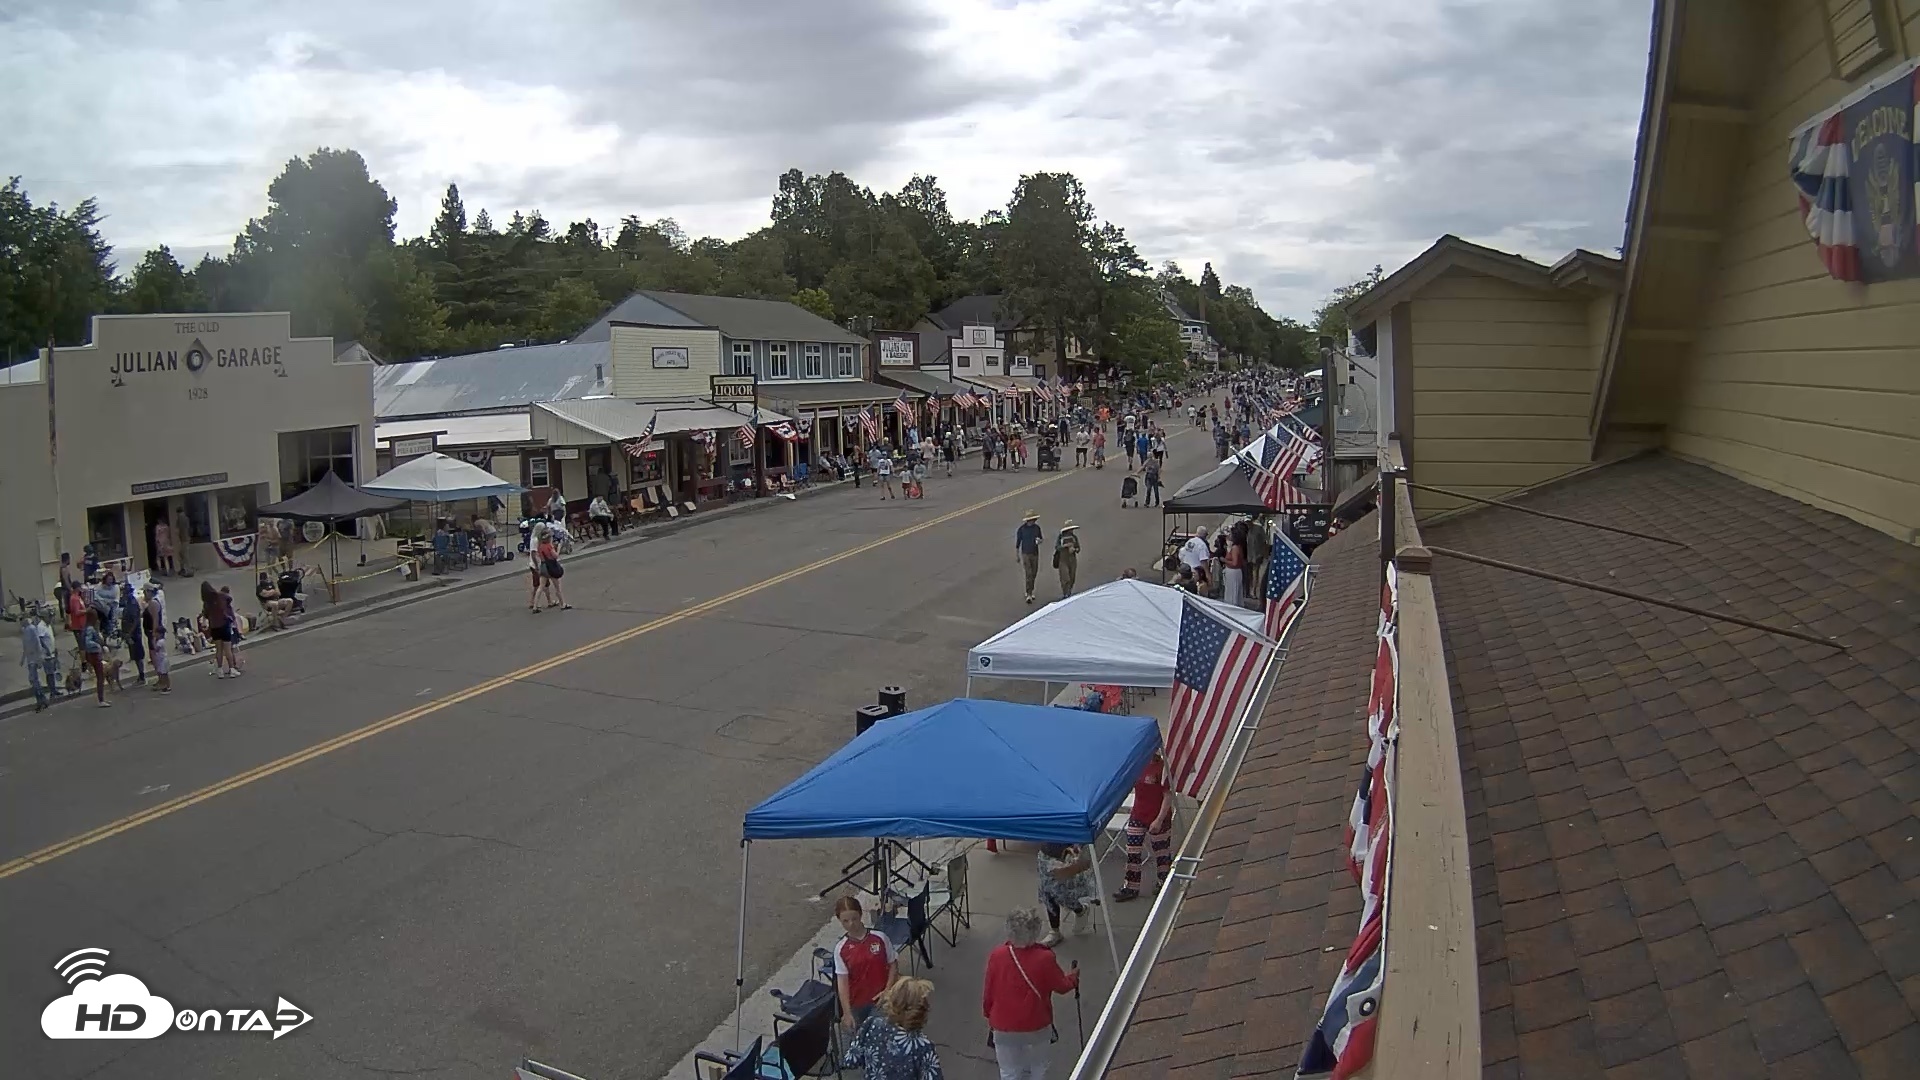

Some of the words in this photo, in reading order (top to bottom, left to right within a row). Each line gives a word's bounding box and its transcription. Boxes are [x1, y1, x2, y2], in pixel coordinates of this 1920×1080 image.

[175, 322, 196, 334] THE
[199, 321, 220, 333] OLD
[110, 350, 178, 374] JULIAN
[217, 346, 283, 367] GARAGE
[714, 385, 754, 396] LIQUOR
